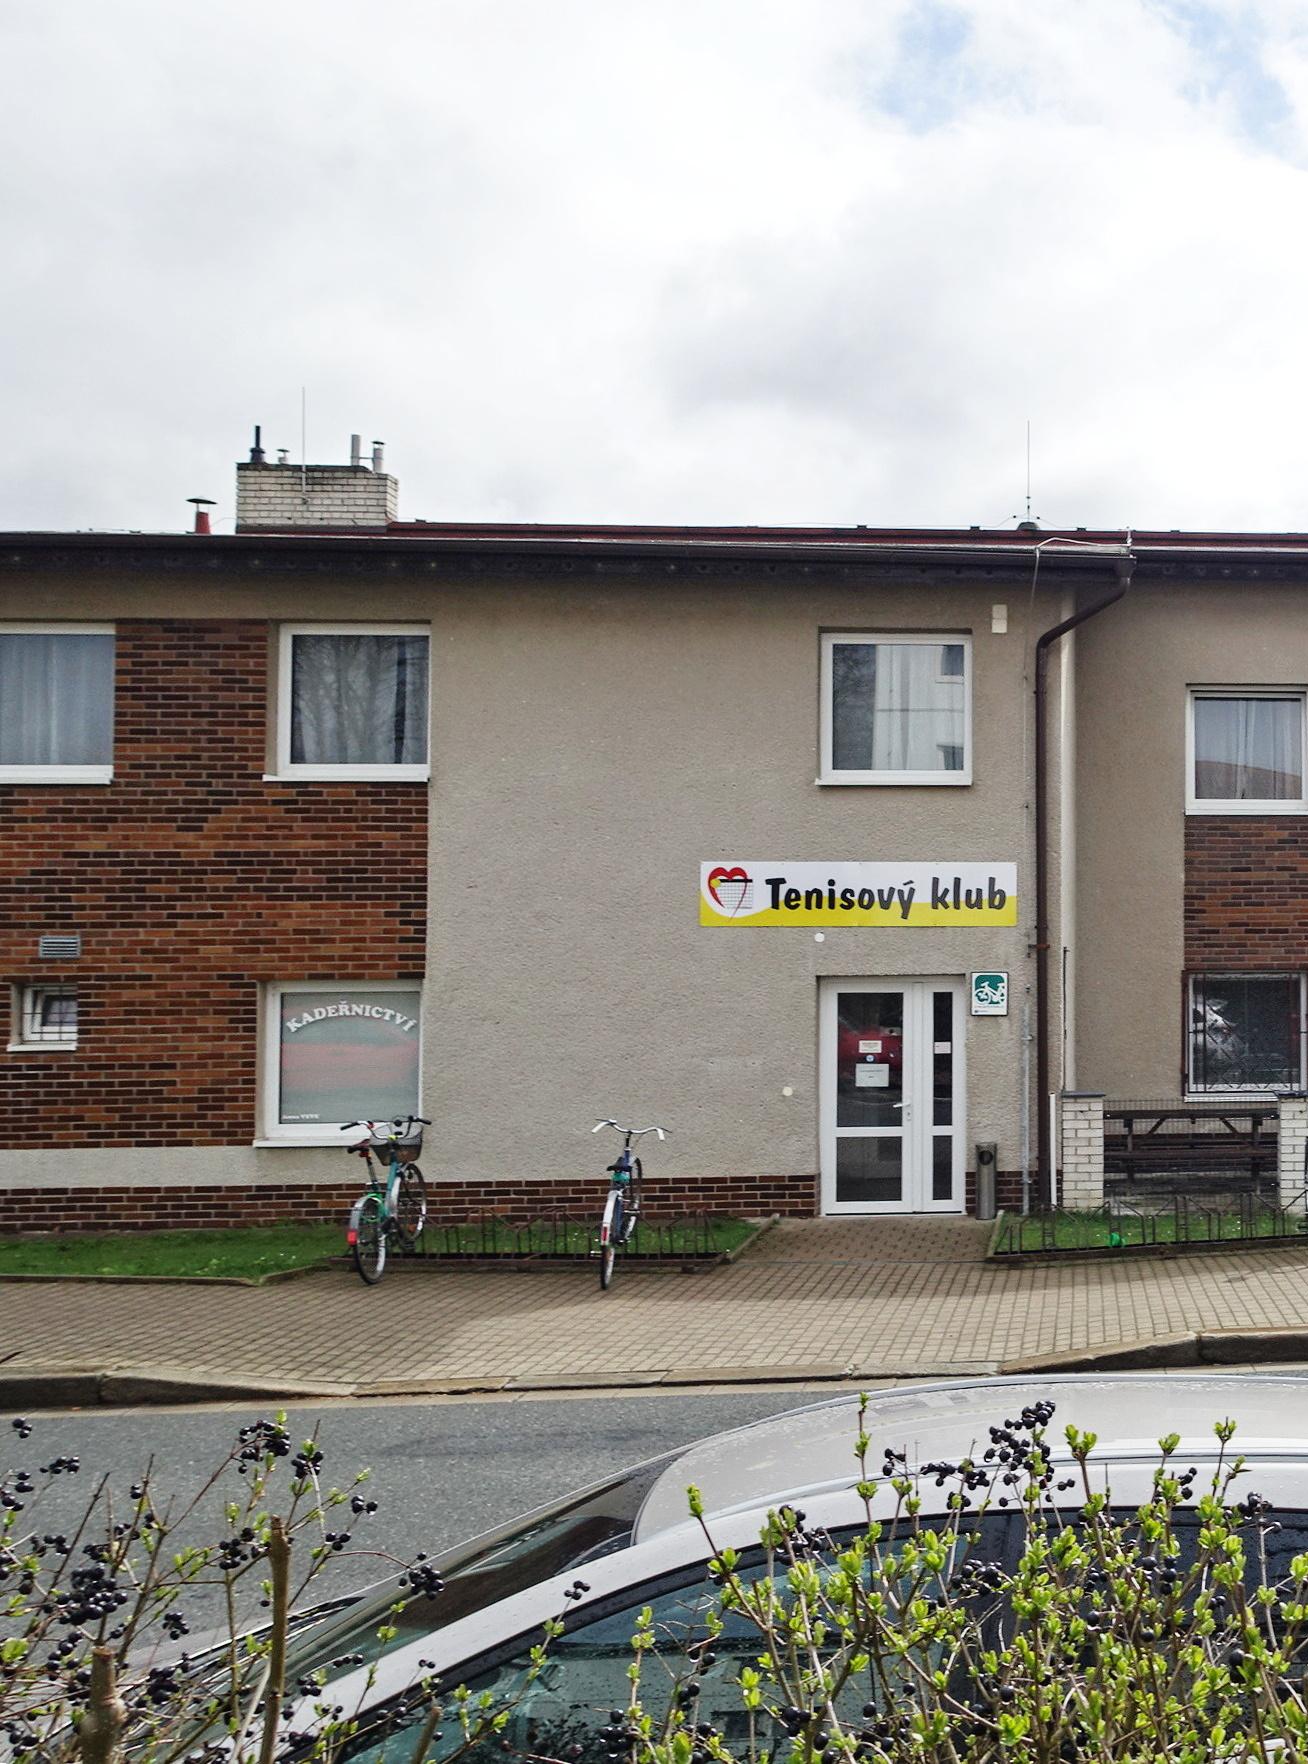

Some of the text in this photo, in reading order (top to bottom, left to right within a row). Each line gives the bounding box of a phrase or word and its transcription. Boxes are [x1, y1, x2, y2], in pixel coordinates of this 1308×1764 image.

[765, 876, 1006, 920] Tenisový klub
[286, 1000, 417, 1033] KADEŘNICTVÍ
